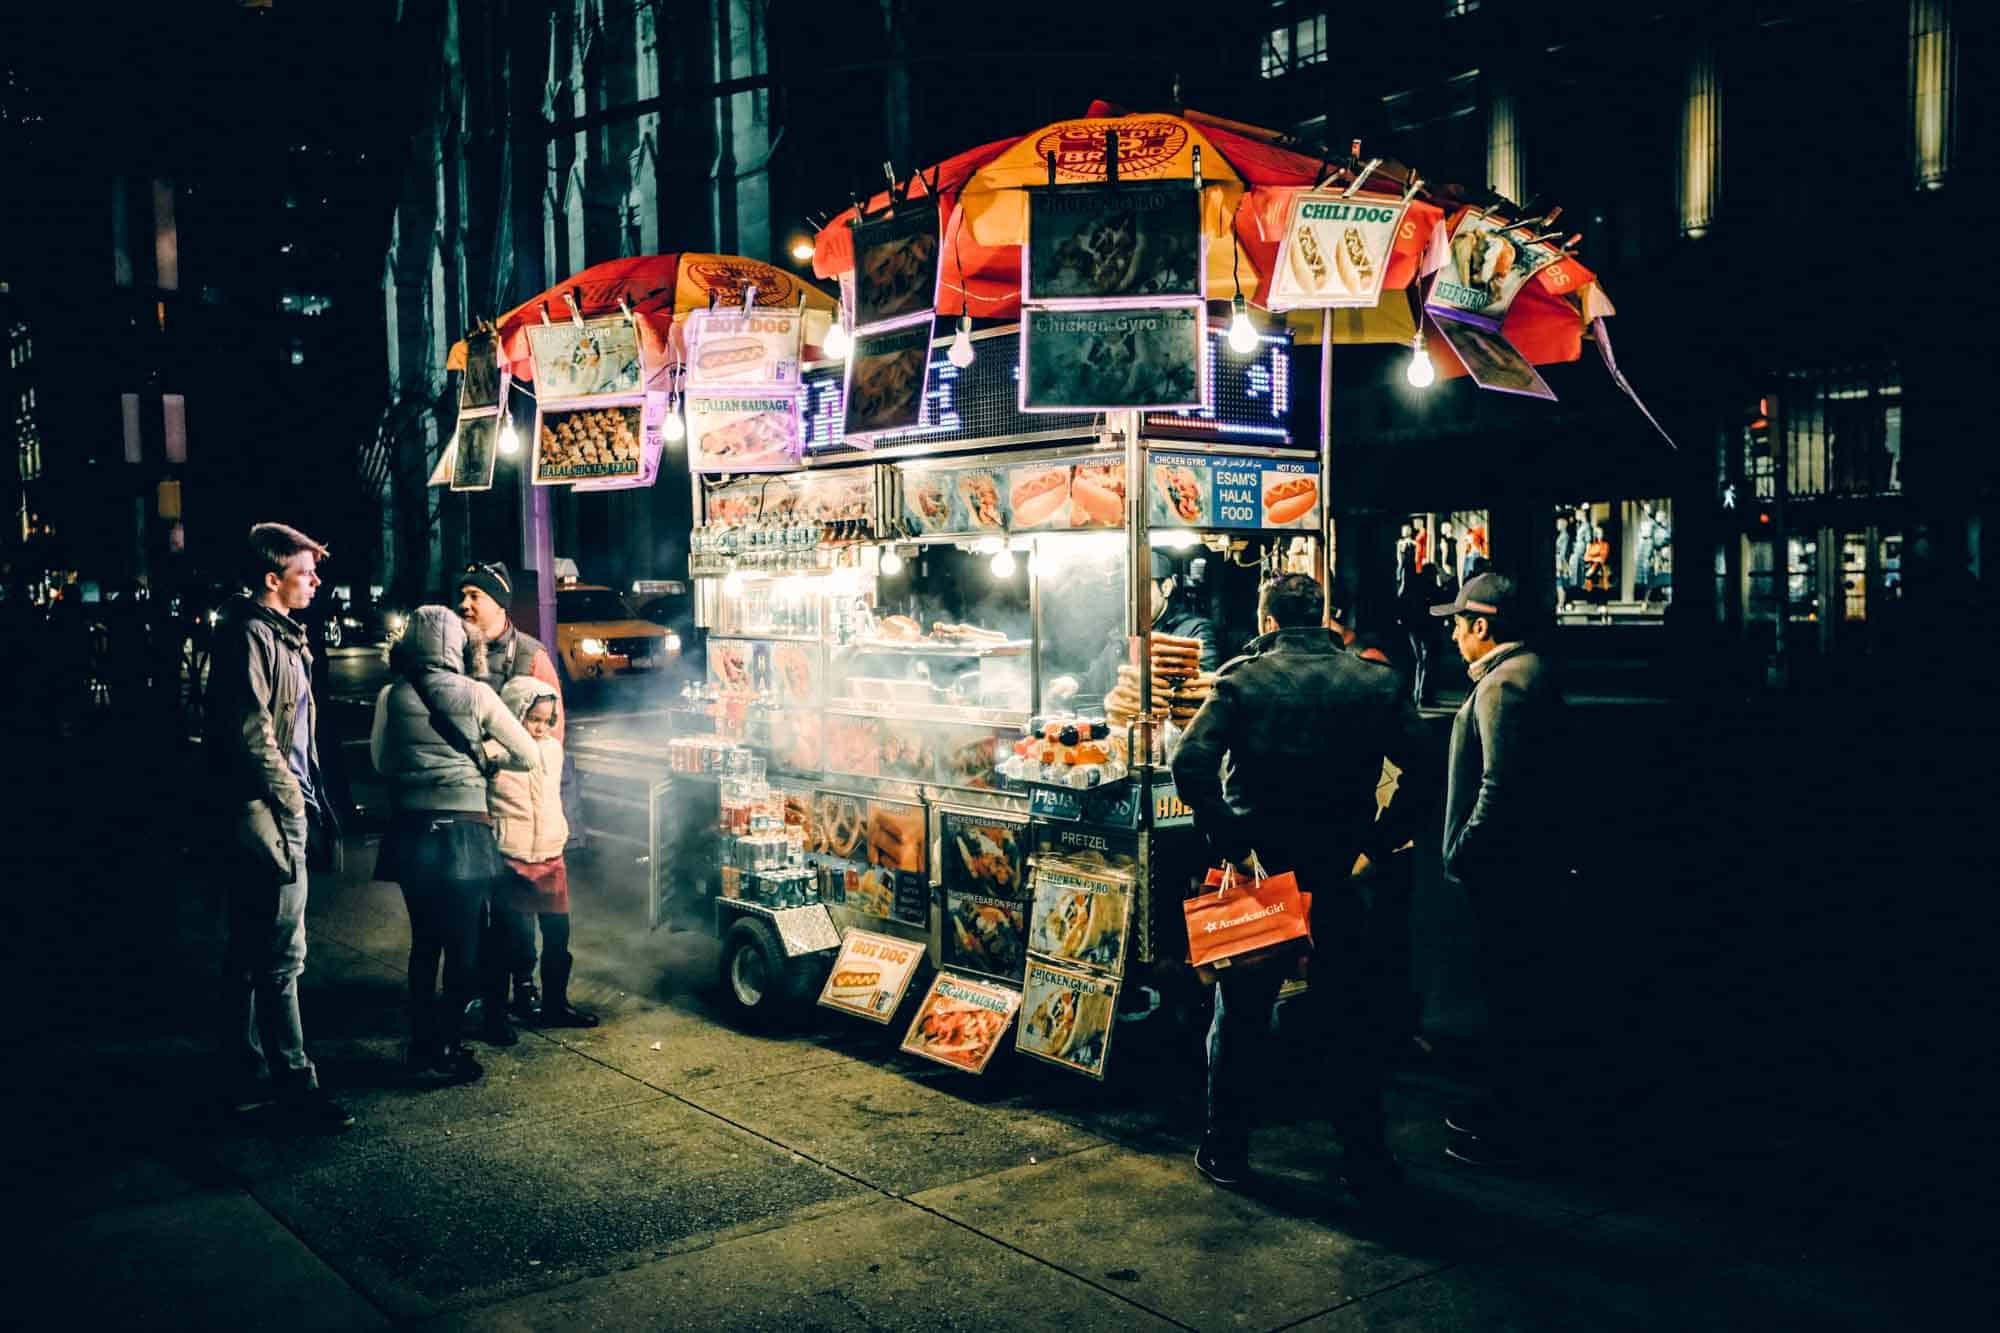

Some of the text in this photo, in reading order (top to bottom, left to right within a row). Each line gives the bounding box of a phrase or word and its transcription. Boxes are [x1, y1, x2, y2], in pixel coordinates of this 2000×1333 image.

[1302, 203, 1393, 223] CHILI DOG
[751, 319, 791, 334] DOG
[1036, 315, 1110, 332] Chicken
[1114, 315, 1157, 335] Gyro
[741, 399, 790, 412] SAUSAGE
[1104, 457, 1120, 466] DOG
[1154, 456, 1206, 466] CHICKEN GYRO
[543, 464, 572, 477] HALAL
[1276, 464, 1305, 473] HOT DOG
[1216, 471, 1257, 487] ESAM'S
[1219, 490, 1254, 504] HALAL
[1221, 506, 1253, 520] FOOD
[1061, 831, 1109, 851] PRETZEL
[852, 940, 909, 964] HOT DOG
[1031, 967, 1069, 985] CHICKEN
